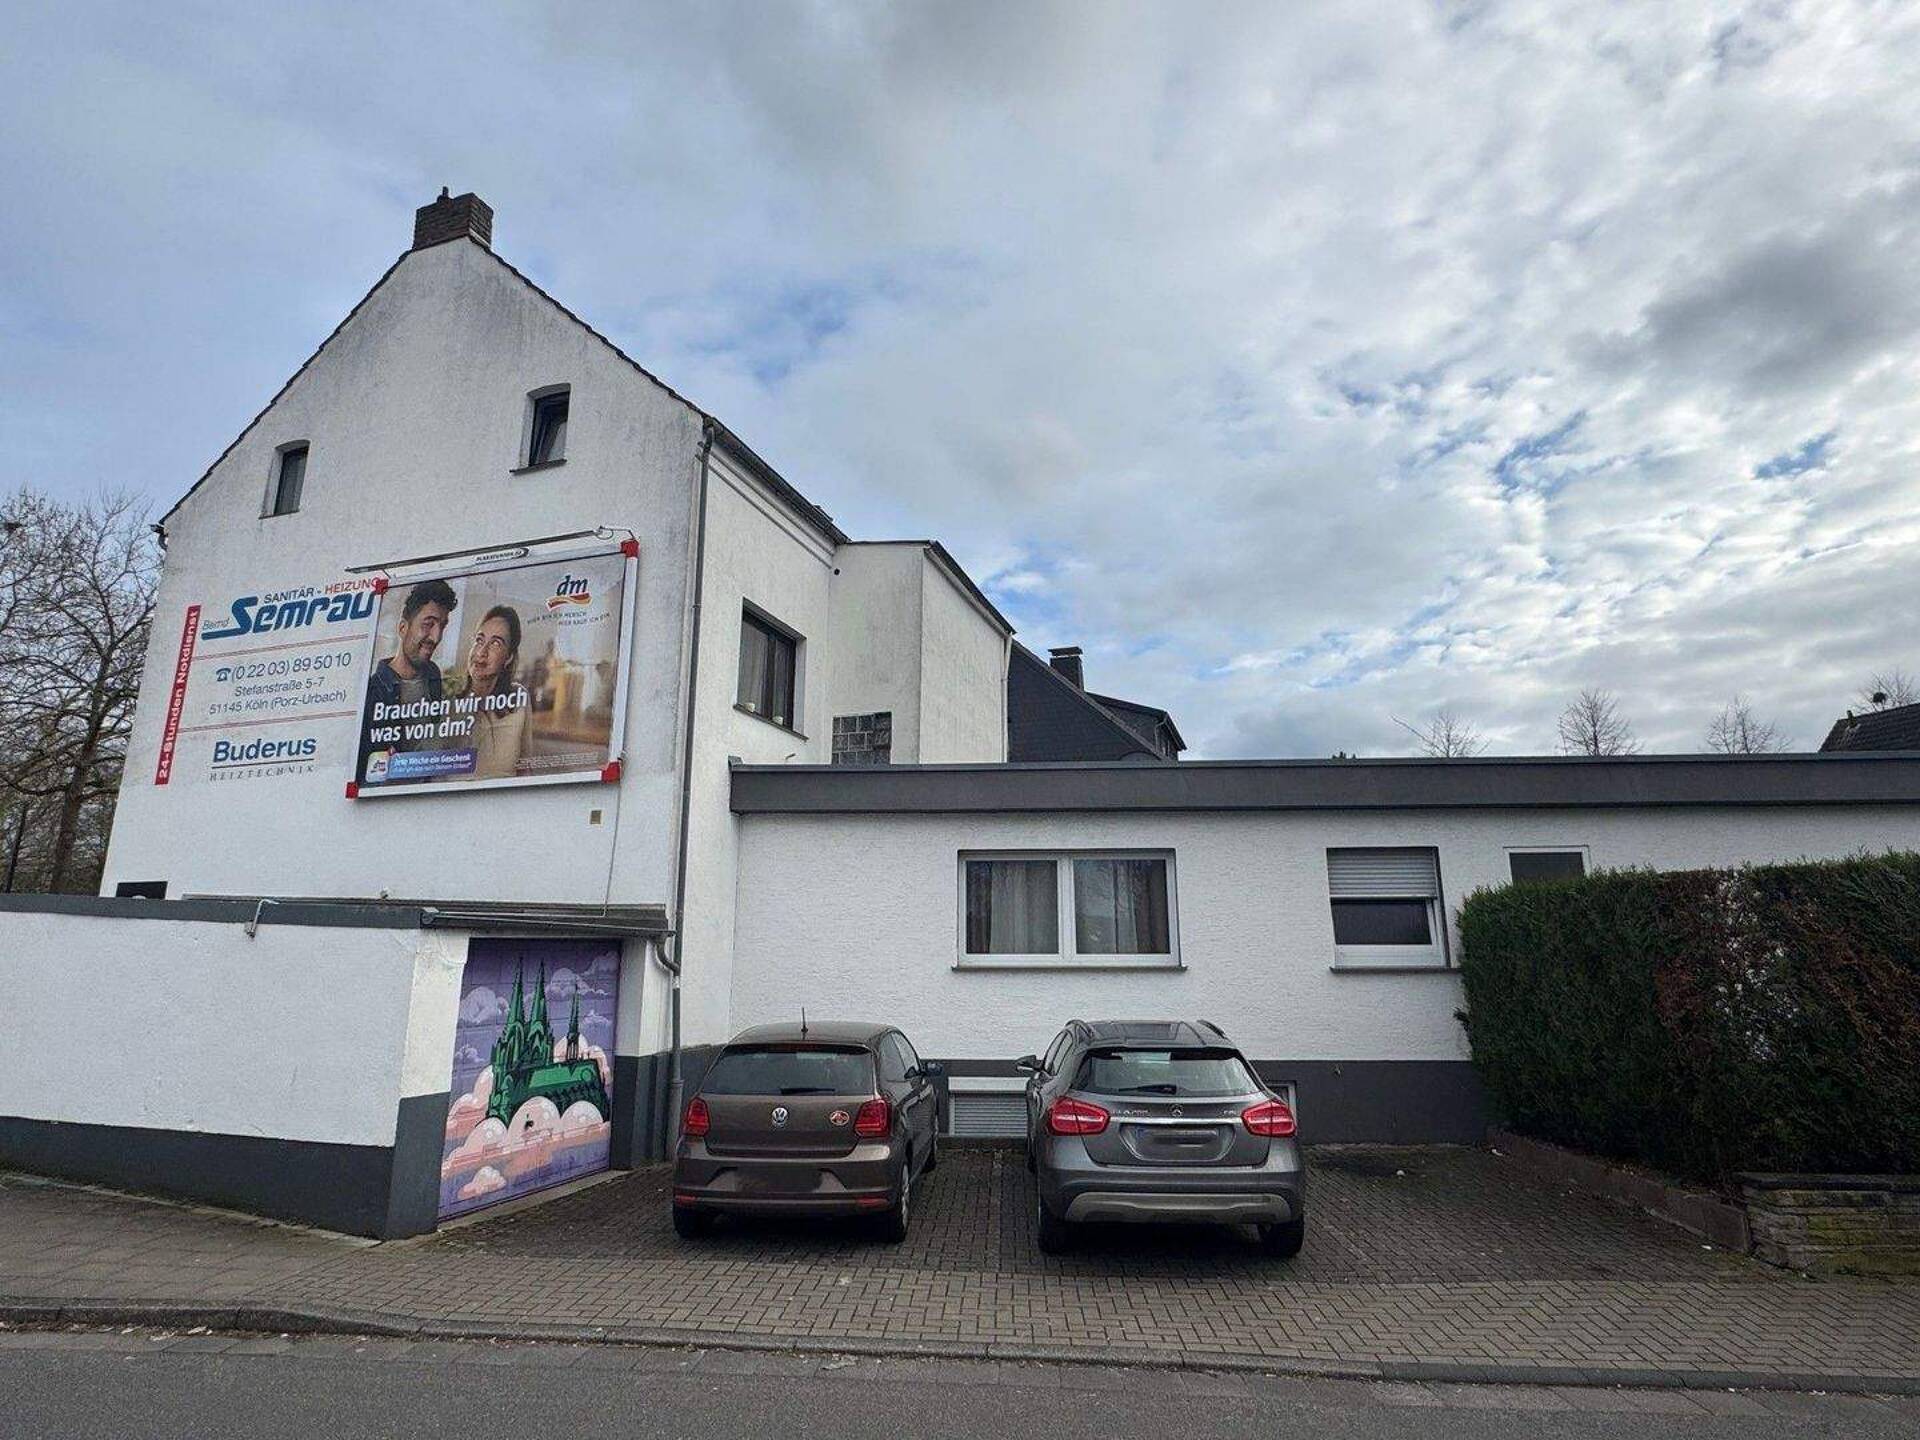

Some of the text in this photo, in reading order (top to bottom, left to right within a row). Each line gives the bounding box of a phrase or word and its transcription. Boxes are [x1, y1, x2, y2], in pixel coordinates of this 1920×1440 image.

[264, 586, 314, 604] SANITÄR
[556, 574, 588, 596] dm
[201, 591, 375, 641] Semrau
[159, 611, 198, 778] 24-Stunden Notdienst
[234, 676, 325, 697] Stefanstraße 5-7
[209, 690, 347, 715] 51145 Köln (Porz-Urbach)
[373, 687, 528, 720] Brauchen wir noch
[371, 716, 475, 743] was von dm?
[213, 738, 317, 763] Buderus
